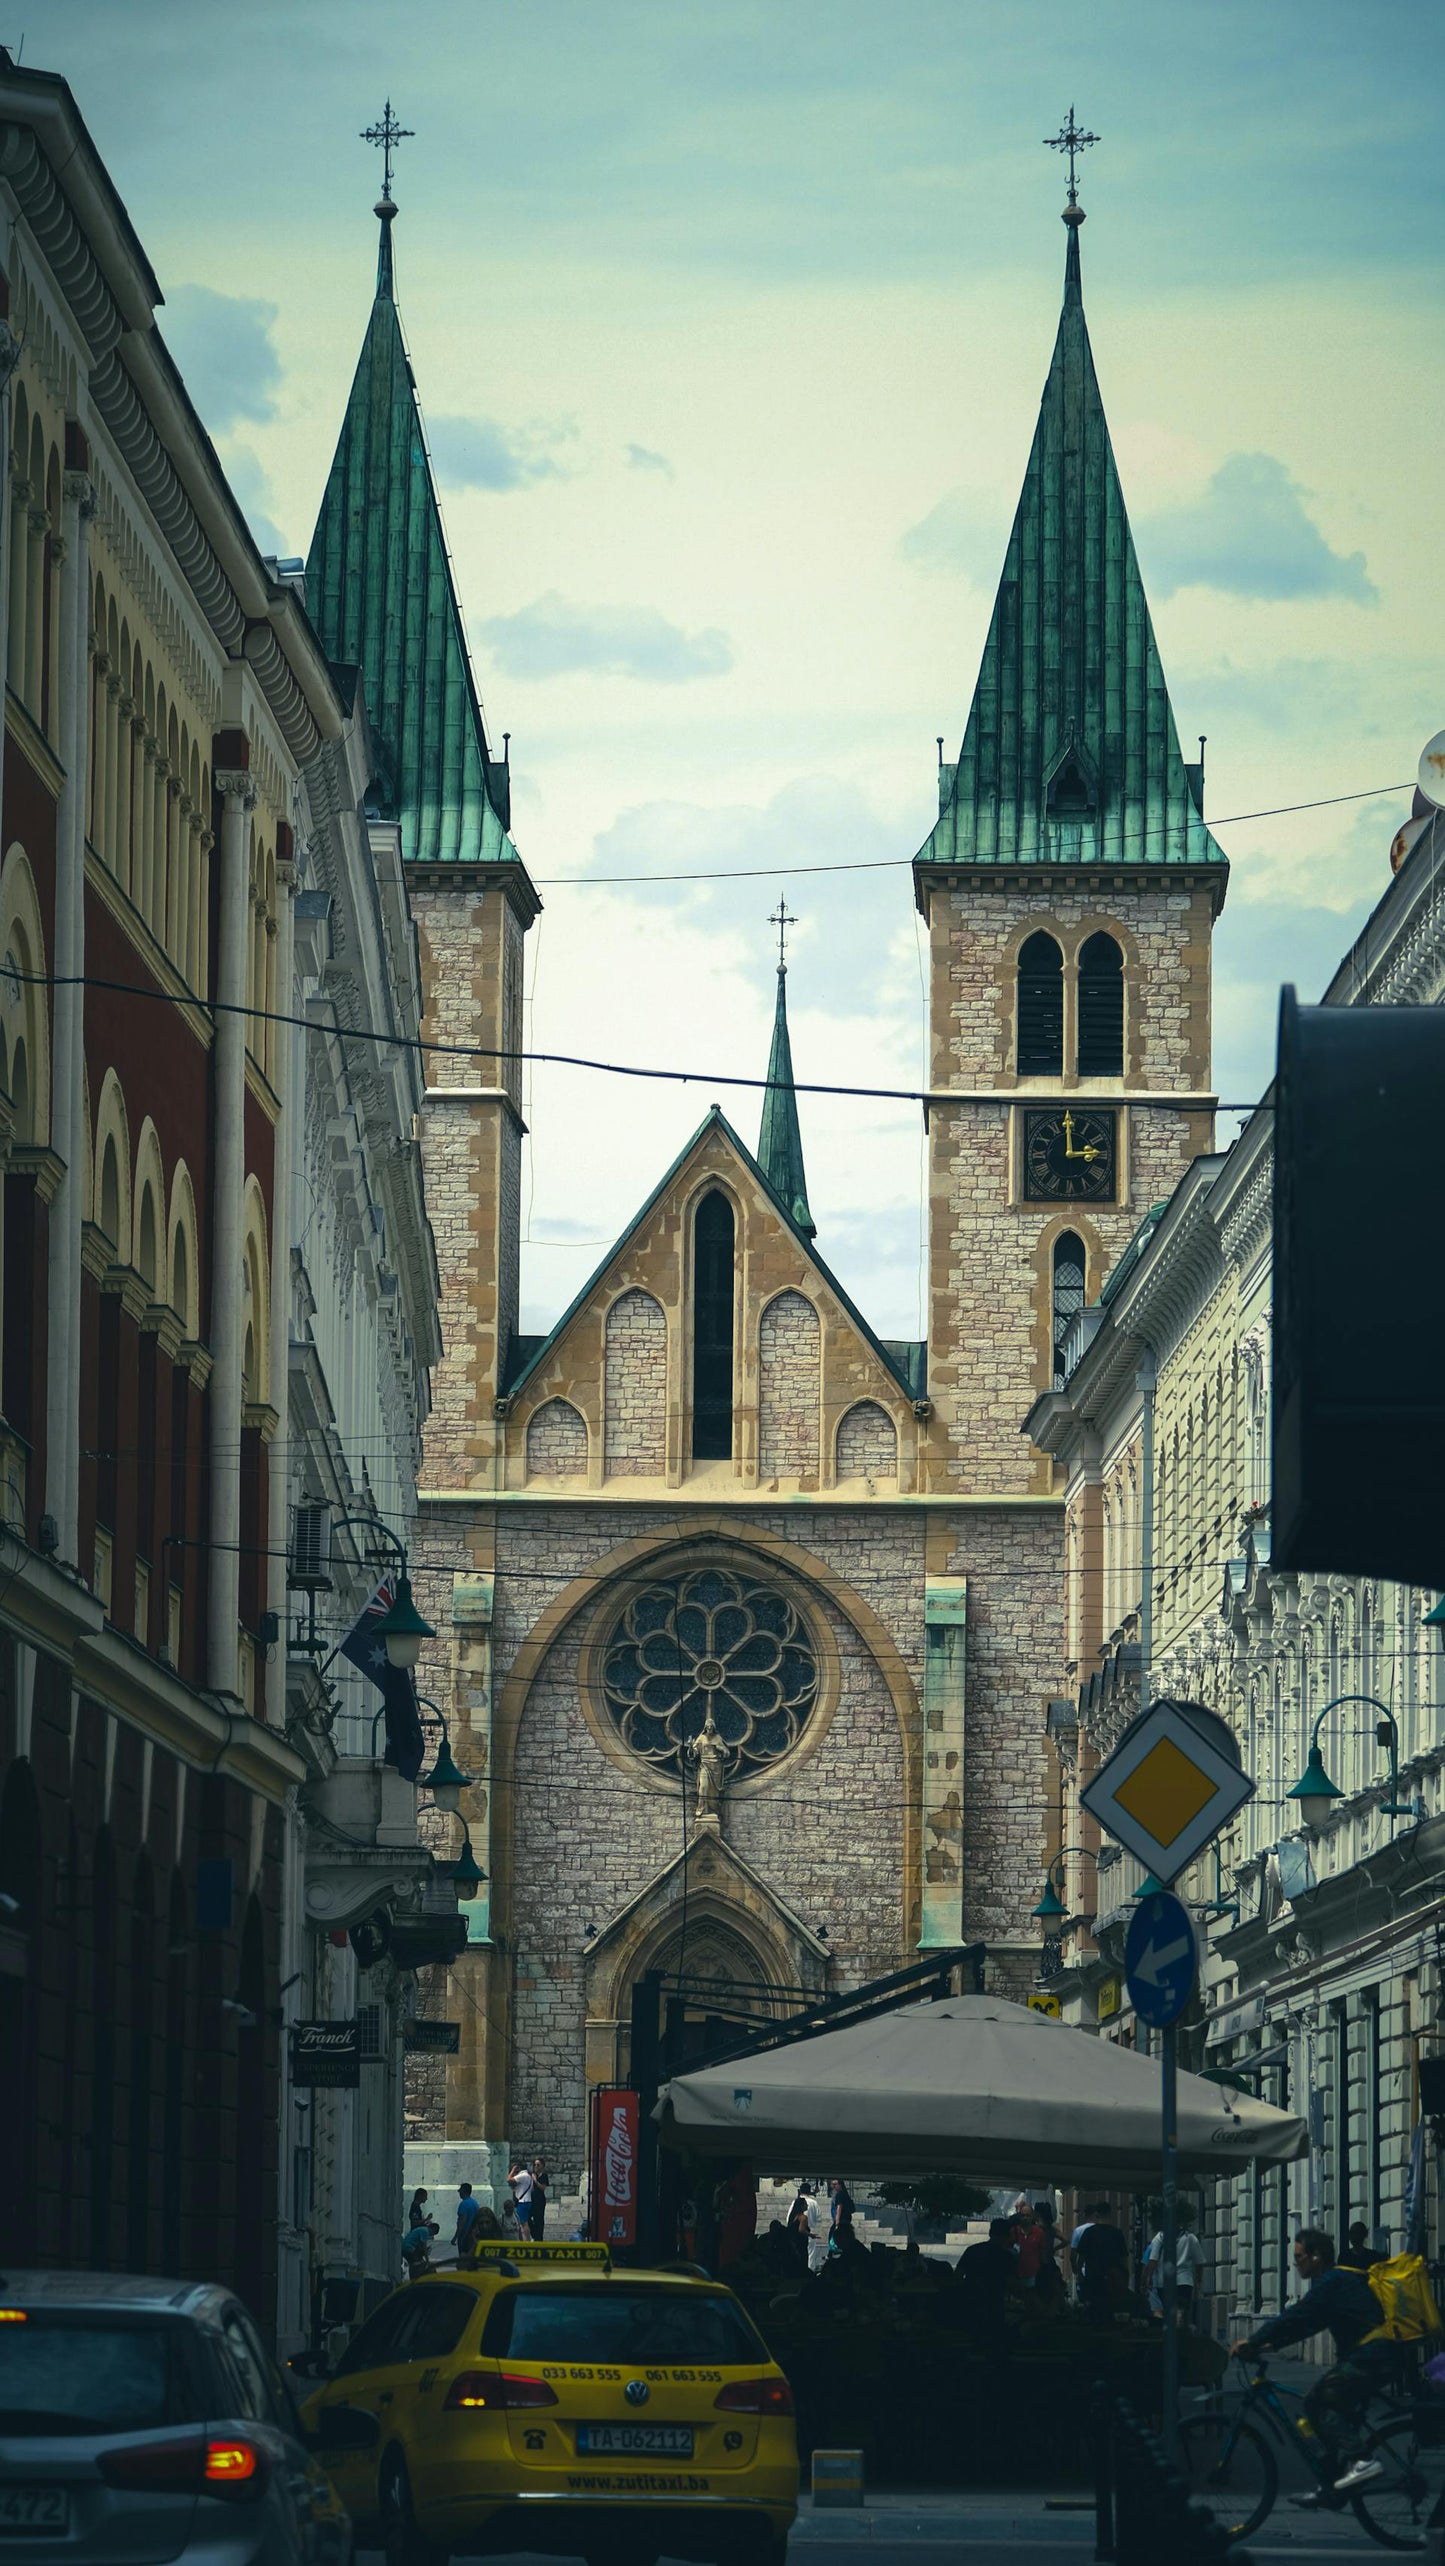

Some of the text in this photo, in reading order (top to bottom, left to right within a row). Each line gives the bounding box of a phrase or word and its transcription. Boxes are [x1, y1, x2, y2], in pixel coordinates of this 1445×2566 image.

[298, 2025, 356, 2045] Franck
[484, 2248, 602, 2259] 007 ZUTI TAXI 007
[542, 2367, 621, 2381] 033 663 555
[644, 2369, 722, 2382] 061 663 555
[589, 2428, 692, 2450] TA-062112
[567, 2475, 709, 2491] www.zutitaxi.ba
